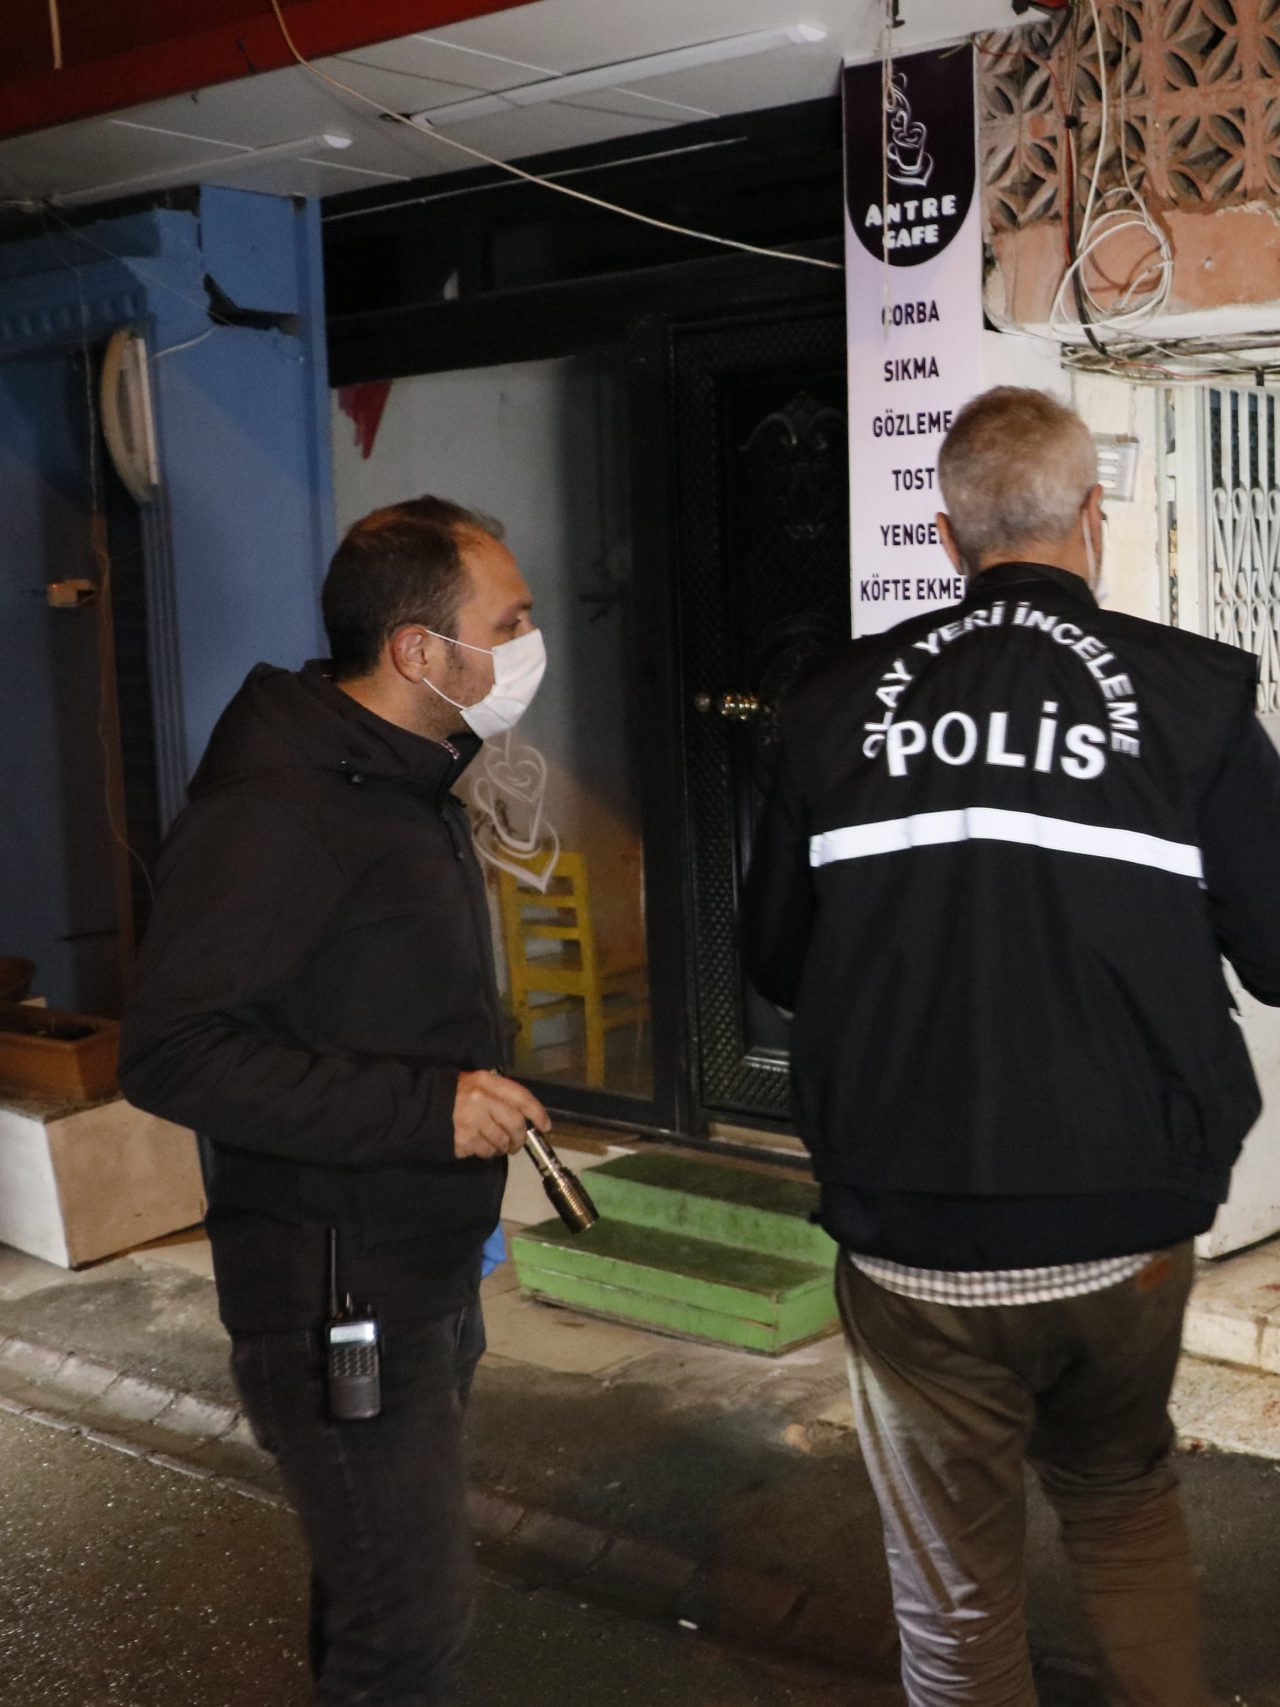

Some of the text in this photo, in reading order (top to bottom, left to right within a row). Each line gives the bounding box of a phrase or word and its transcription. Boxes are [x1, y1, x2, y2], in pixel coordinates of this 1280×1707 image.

[865, 195, 957, 228] ANTRE
[883, 224, 940, 249] CAFE
[883, 356, 940, 382] SIKMA
[872, 408, 953, 438] GÖZLEME
[892, 466, 936, 491] TOST
[880, 522, 944, 546] YENGE
[860, 573, 967, 601] KÖFTE EKME
[862, 601, 1140, 760] OLAY YERİ İNCELEME
[887, 700, 1106, 780] POLİS
